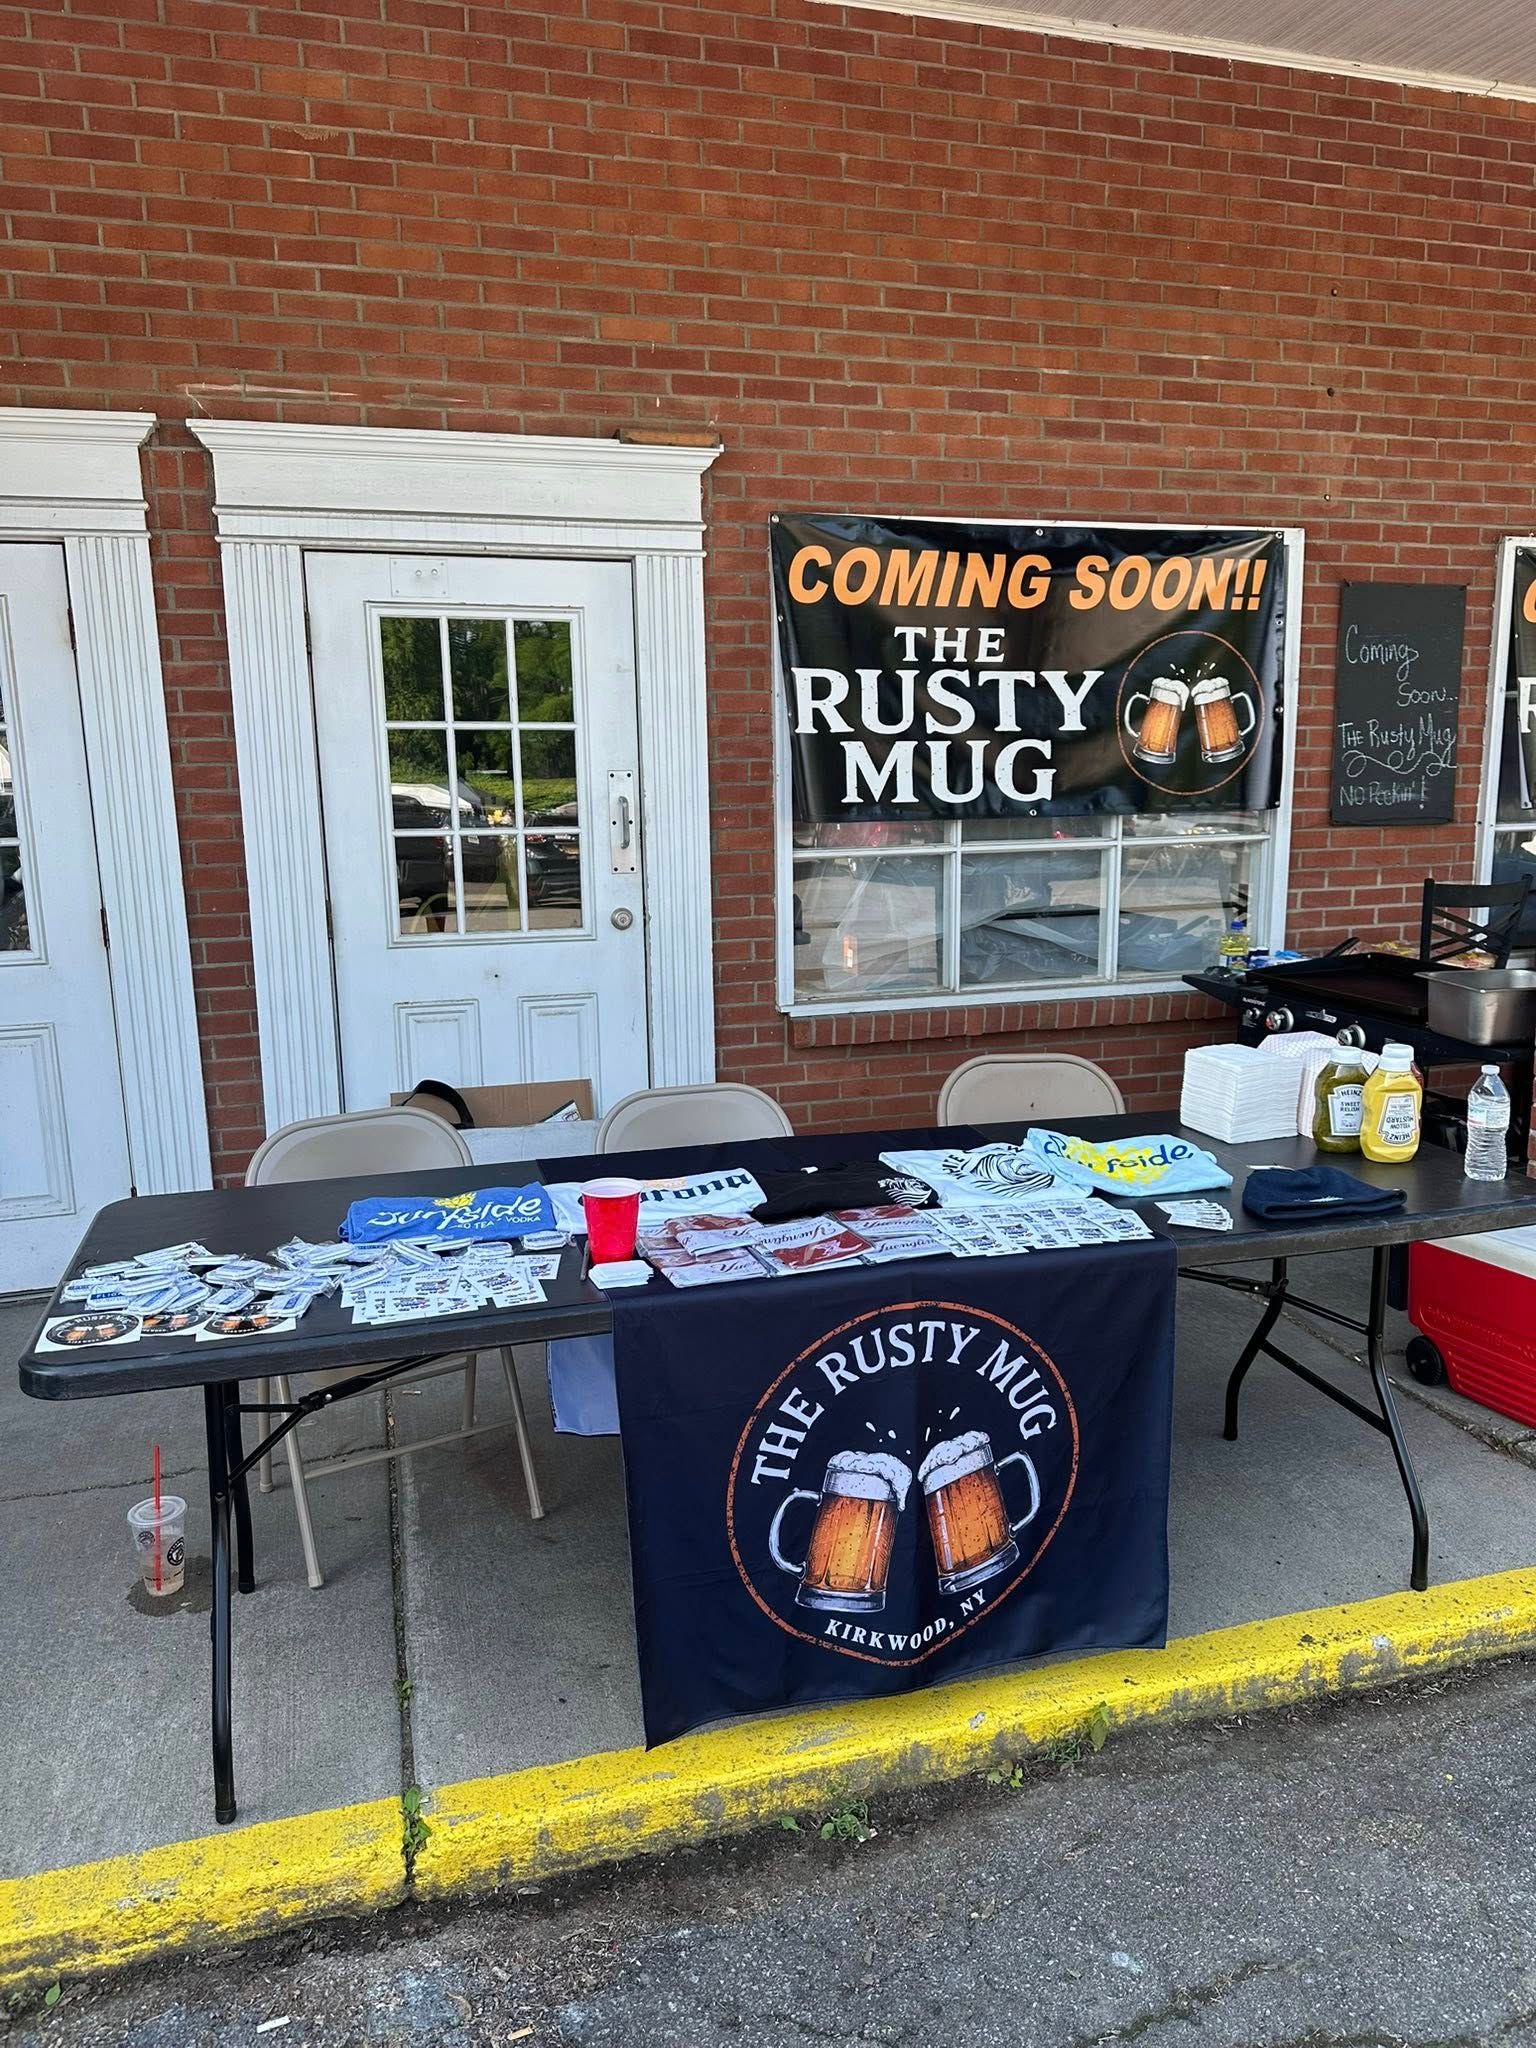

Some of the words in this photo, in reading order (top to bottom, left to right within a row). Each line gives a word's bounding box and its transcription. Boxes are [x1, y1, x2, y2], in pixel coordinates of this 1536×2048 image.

[788, 545, 1051, 609] COMING
[1069, 555, 1268, 611] SOON!!
[894, 627, 1006, 663] THE
[1345, 624, 1419, 682] Coming
[790, 667, 1104, 734] RUSTY
[1368, 719, 1415, 760] Rusty
[1418, 712, 1458, 768] Mug
[840, 738, 1057, 803] MUG
[1340, 1089, 1362, 1097] HEINZ
[1385, 1115, 1414, 1124] MUSTARD
[1389, 1132, 1411, 1141] HEINZ
[640, 1173, 753, 1204] rona
[472, 1220, 495, 1230] TEA
[504, 1214, 542, 1224] VODKA
[751, 1388, 825, 1486] THE
[815, 1320, 981, 1396] RUSTY
[976, 1339, 1057, 1441] MUG
[824, 1617, 955, 1652] KIRKWOOD,
[959, 1588, 987, 1618] NY
